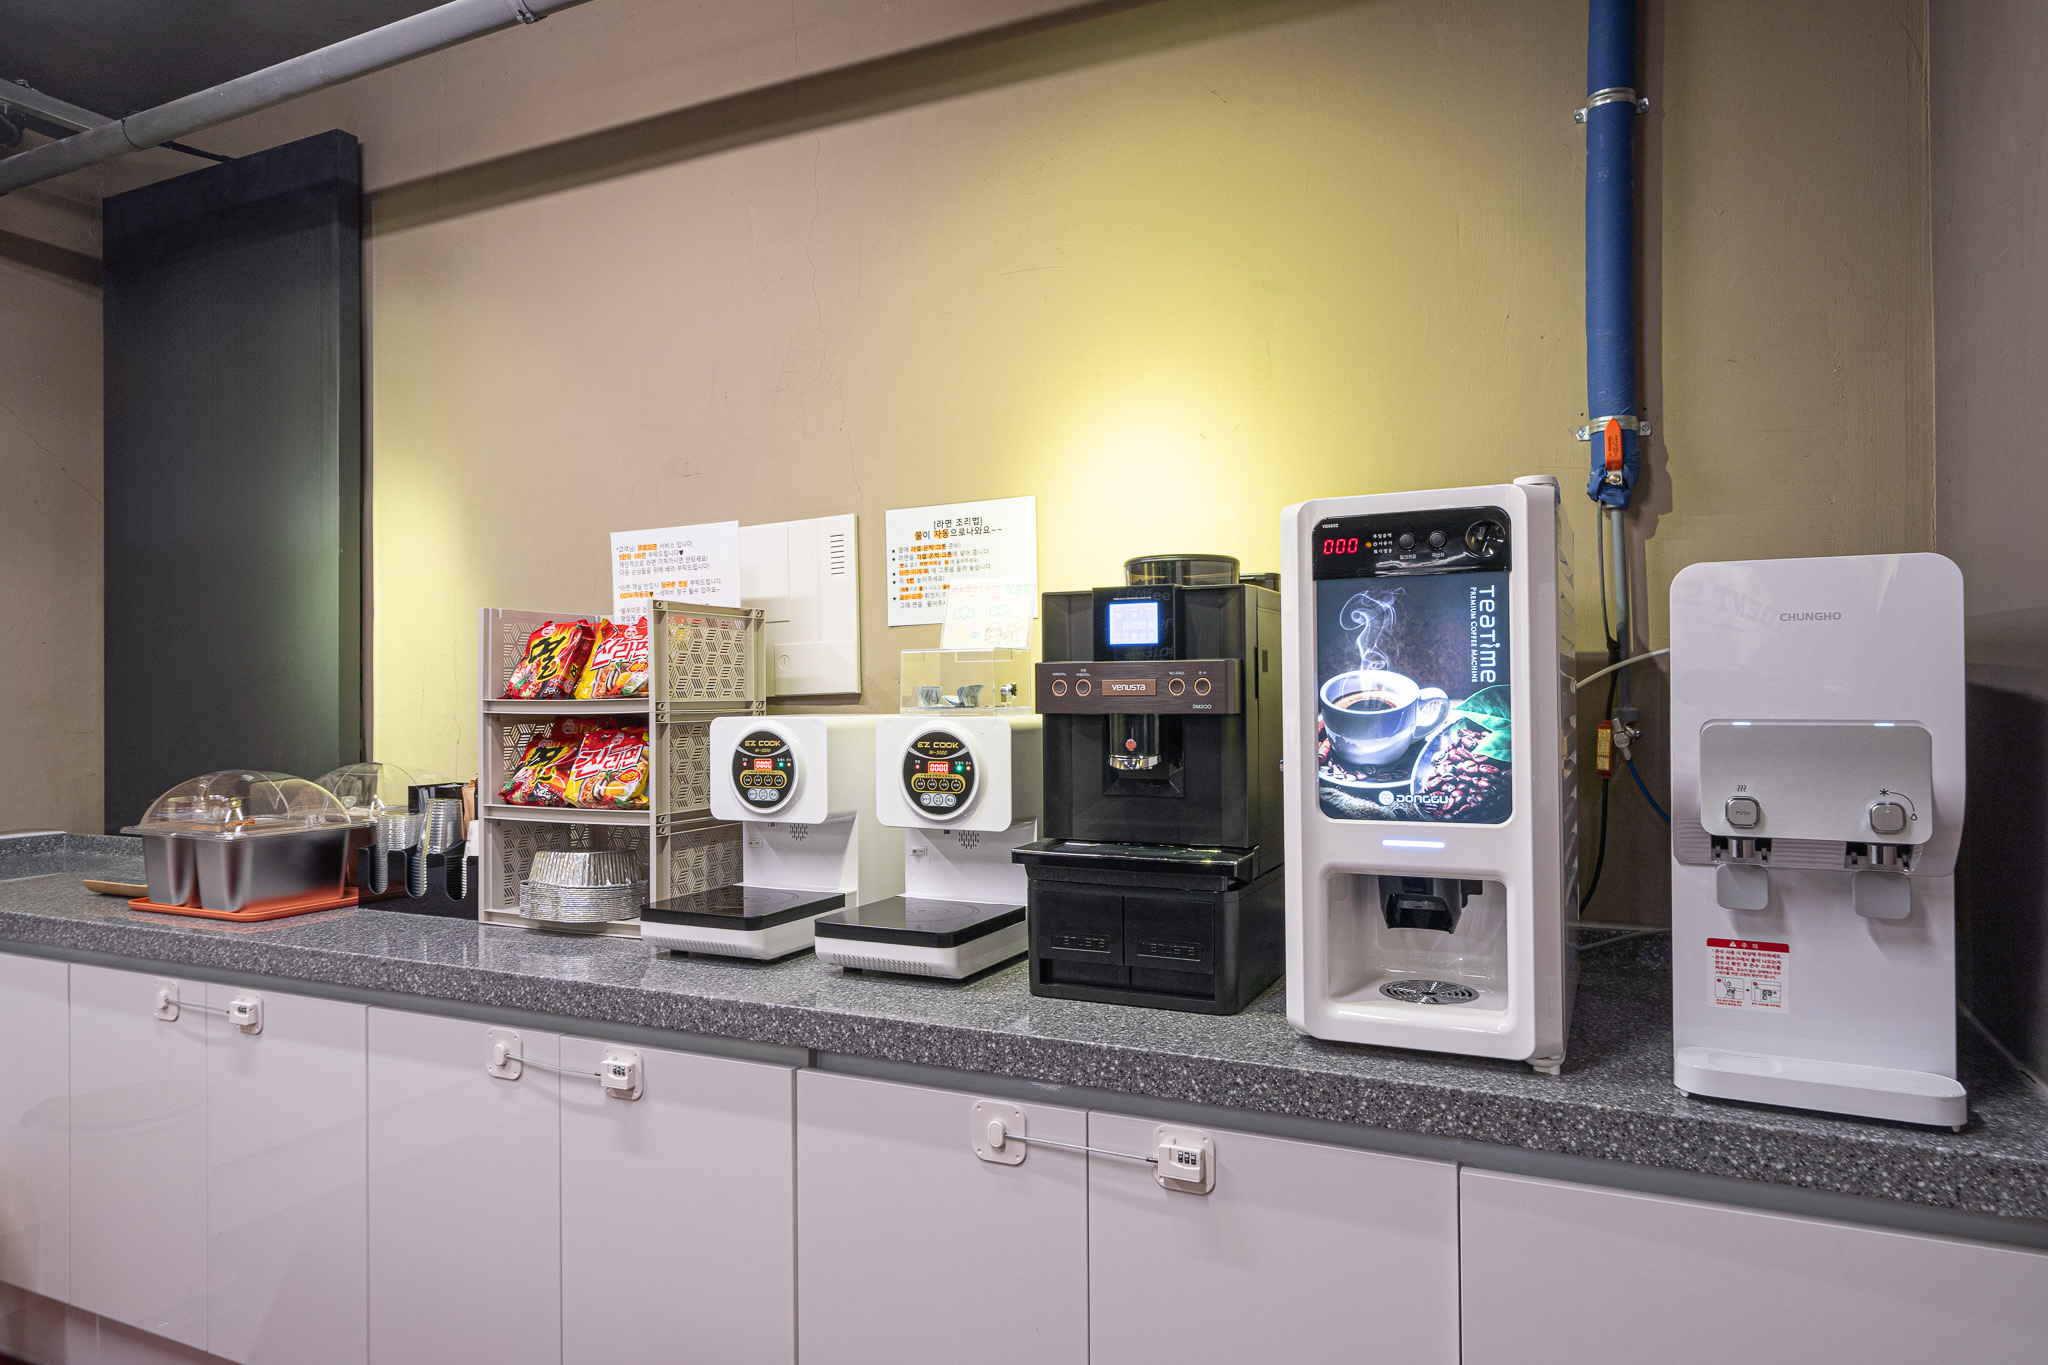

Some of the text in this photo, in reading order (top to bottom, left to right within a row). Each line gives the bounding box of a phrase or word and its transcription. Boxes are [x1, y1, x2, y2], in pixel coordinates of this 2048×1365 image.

[933, 516, 983, 530] [라면 조리법]
[914, 530, 930, 541] 물이
[1323, 537, 1359, 555] 000
[620, 614, 636, 622] 맛있게
[1779, 611, 1842, 622] CHUNGHO
[1470, 621, 1478, 647] COFFEE
[1470, 649, 1478, 683] MACHINE
[933, 741, 958, 749] COOK
[574, 744, 644, 782] 진라면
[929, 763, 948, 772] 0000
[1396, 794, 1449, 804] DONGGU
